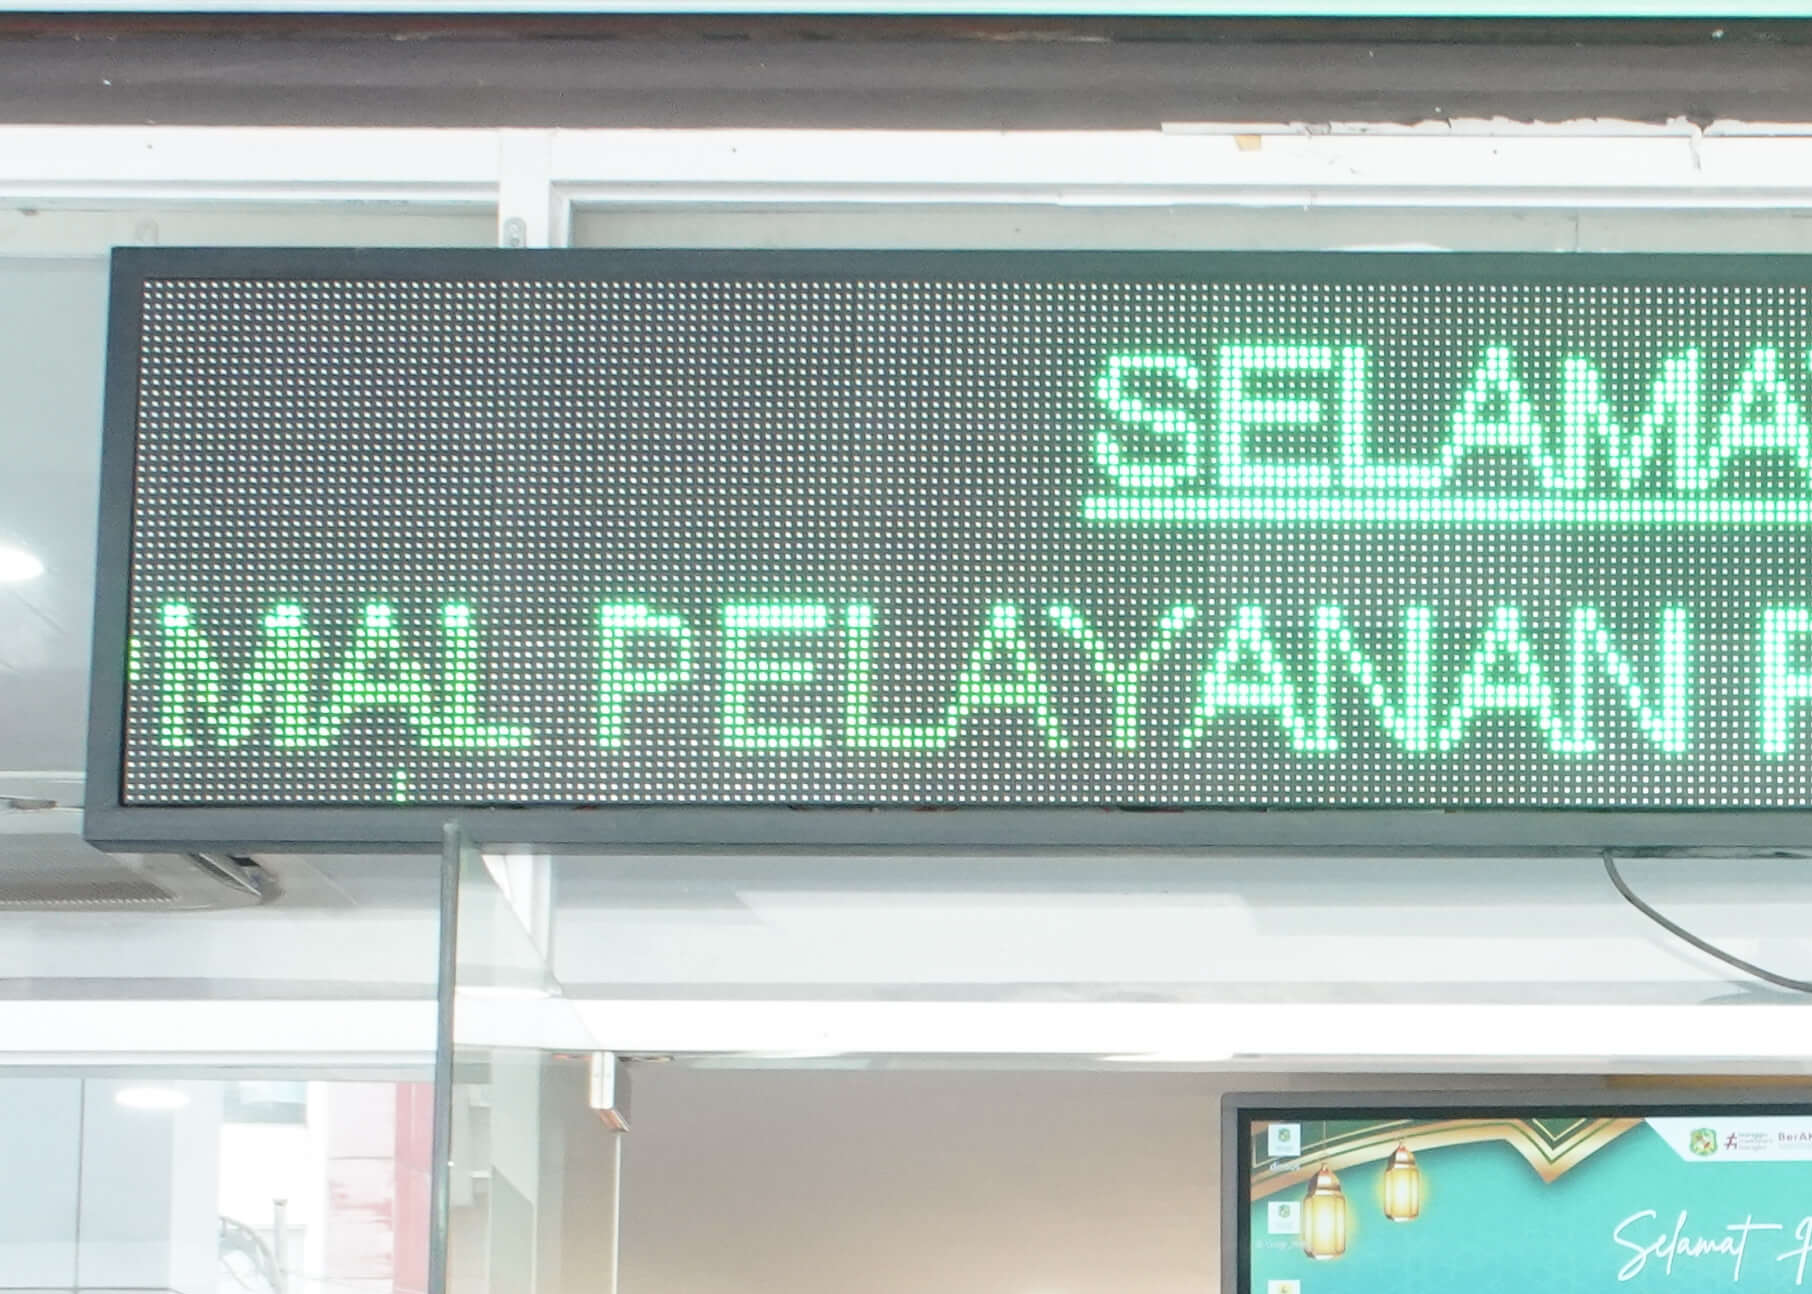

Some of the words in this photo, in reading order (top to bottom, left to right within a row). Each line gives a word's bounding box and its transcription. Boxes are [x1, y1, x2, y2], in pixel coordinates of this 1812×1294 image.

[157, 600, 533, 751] MAL
[595, 601, 1690, 755] PELAYANAN
[1612, 1209, 1783, 1283] Selamat
